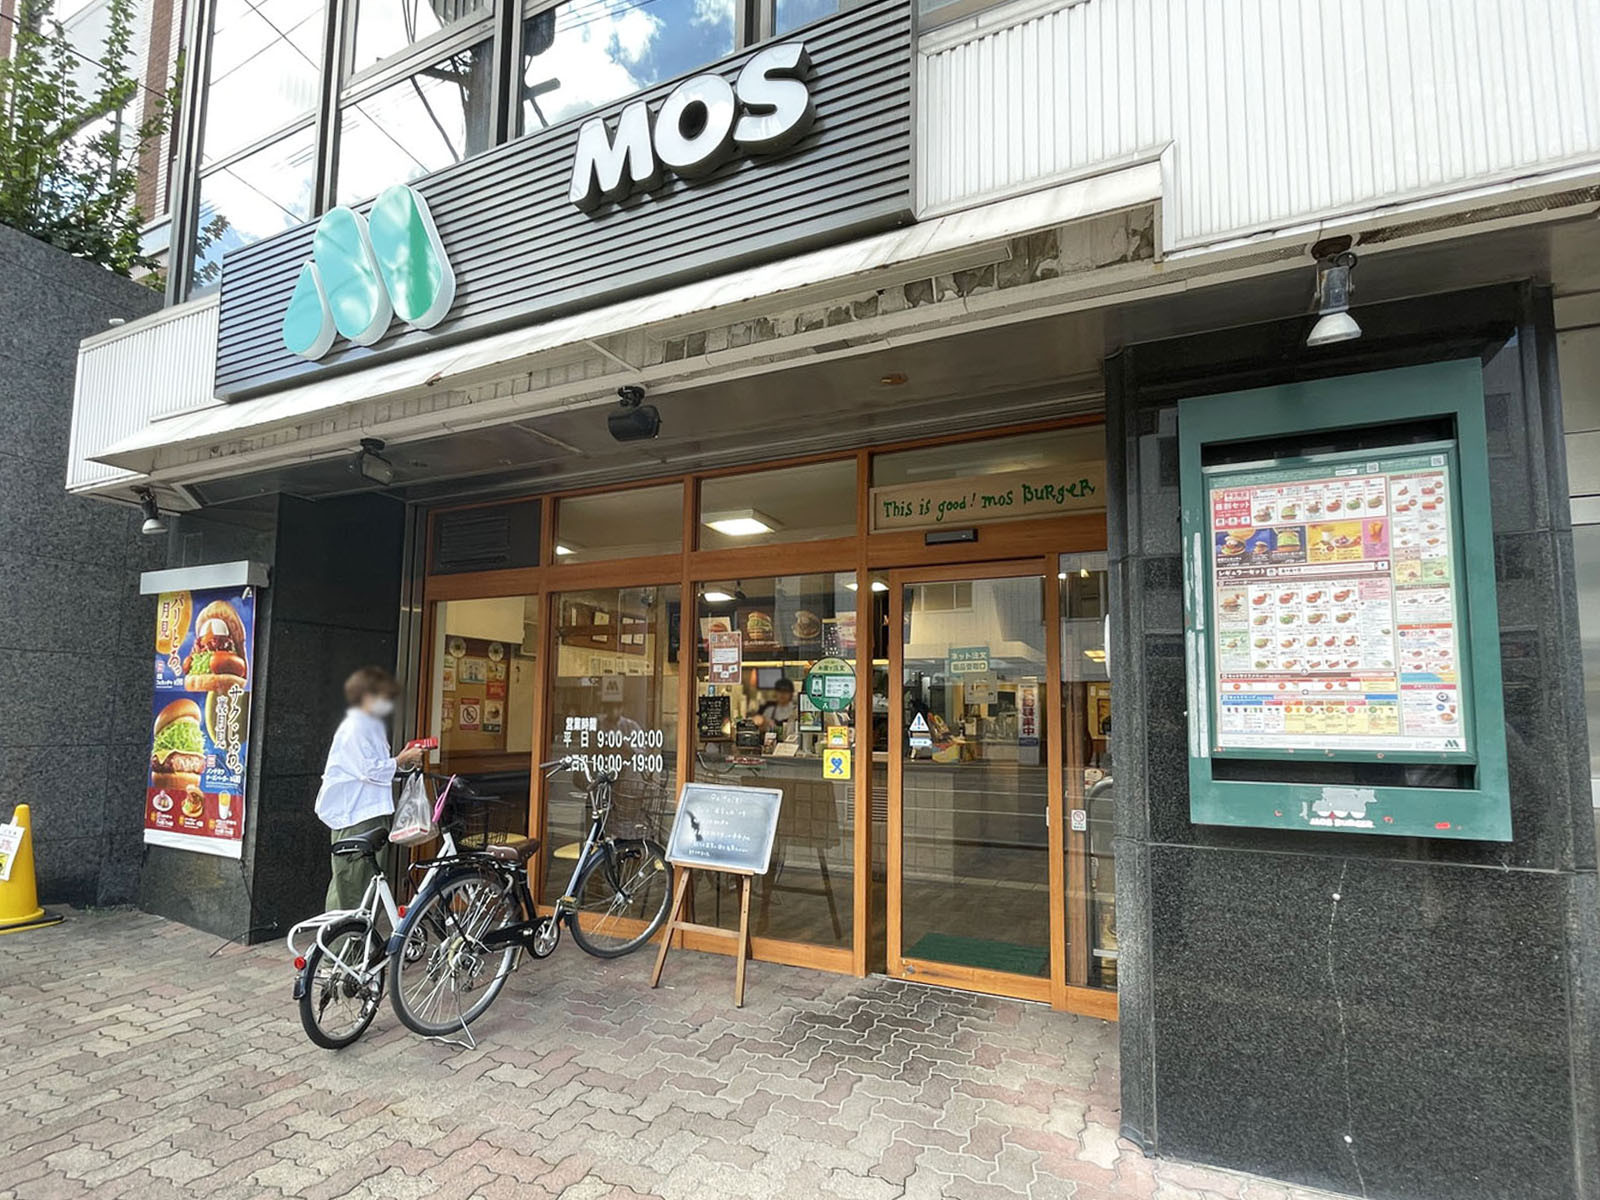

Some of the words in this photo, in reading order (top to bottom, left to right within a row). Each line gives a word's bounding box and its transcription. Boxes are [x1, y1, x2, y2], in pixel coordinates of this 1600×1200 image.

[568, 42, 811, 205] MOS
[883, 499, 913, 518] This
[919, 497, 931, 515] is
[161, 601, 170, 638] 月見
[566, 716, 598, 731] 営業時間
